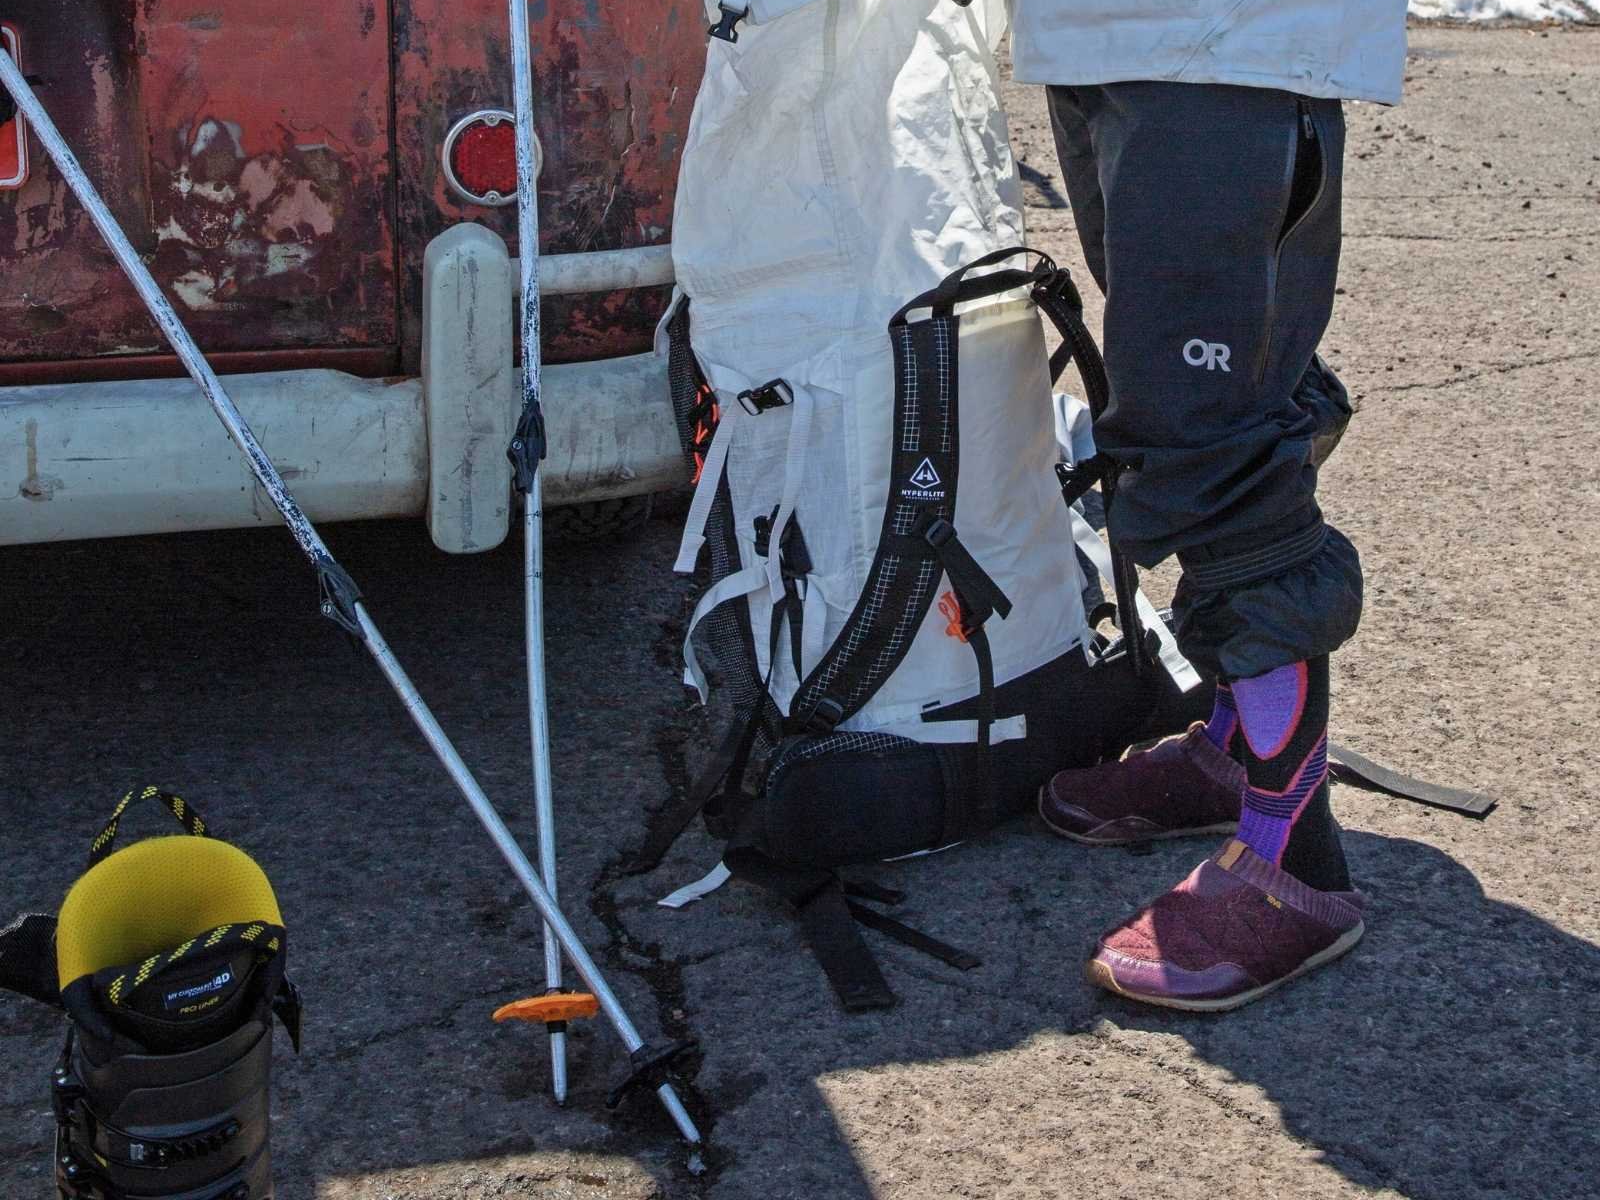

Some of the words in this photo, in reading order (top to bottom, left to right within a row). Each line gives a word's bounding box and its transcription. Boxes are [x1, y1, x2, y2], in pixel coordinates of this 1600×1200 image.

[1183, 338, 1232, 372] OR
[901, 489, 945, 498] HYPERLITE
[215, 972, 230, 986] 4D
